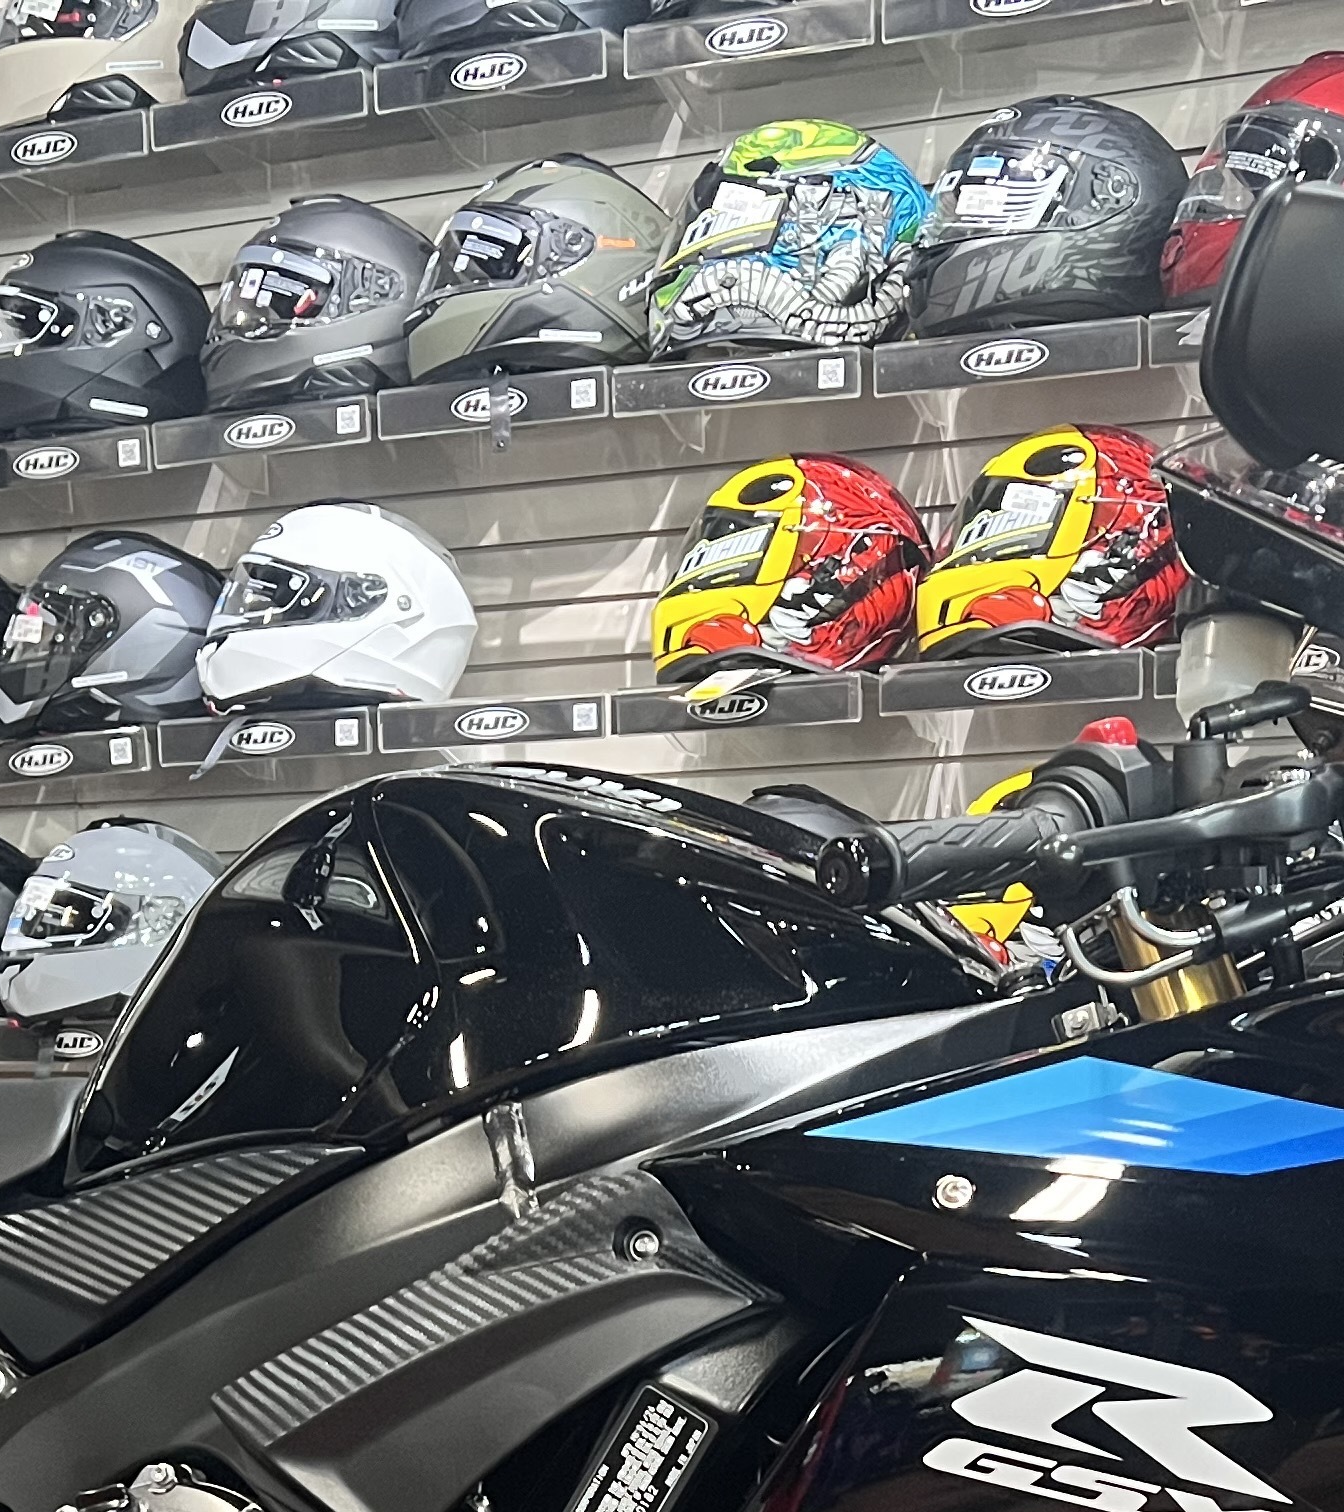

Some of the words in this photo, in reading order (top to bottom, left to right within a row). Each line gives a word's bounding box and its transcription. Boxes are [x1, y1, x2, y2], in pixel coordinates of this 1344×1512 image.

[719, 26, 774, 47] HJC
[464, 61, 514, 81] HJC
[233, 100, 280, 120] HJC
[22, 140, 66, 158] HJC
[974, 348, 1034, 368] HJC
[702, 373, 757, 391] HJC
[236, 423, 284, 441] HJC
[25, 454, 68, 471] HJC
[978, 672, 1036, 691] HJC
[466, 715, 517, 732] HJC
[237, 730, 283, 746] HJC
[19, 752, 62, 769] HJC
[950, 1310, 1295, 1505] R
